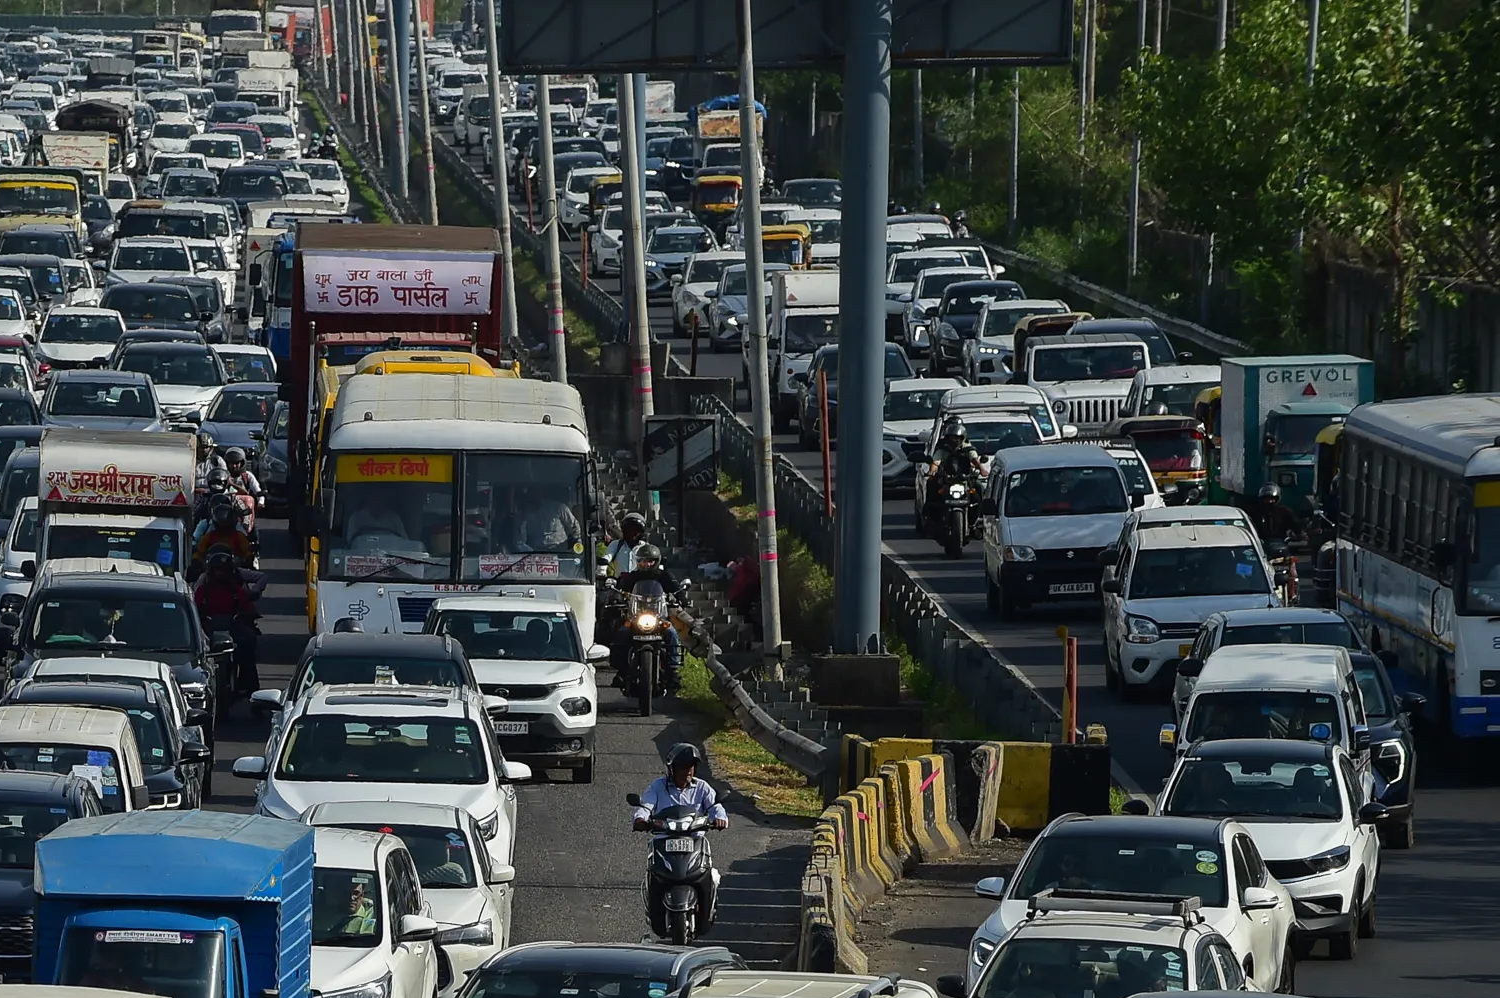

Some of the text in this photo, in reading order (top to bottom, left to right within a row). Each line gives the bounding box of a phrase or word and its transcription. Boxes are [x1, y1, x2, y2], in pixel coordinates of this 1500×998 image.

[347, 269, 370, 281] जय
[337, 282, 449, 307] डाक पार्सल
[358, 456, 429, 476] सीकर डिपो
